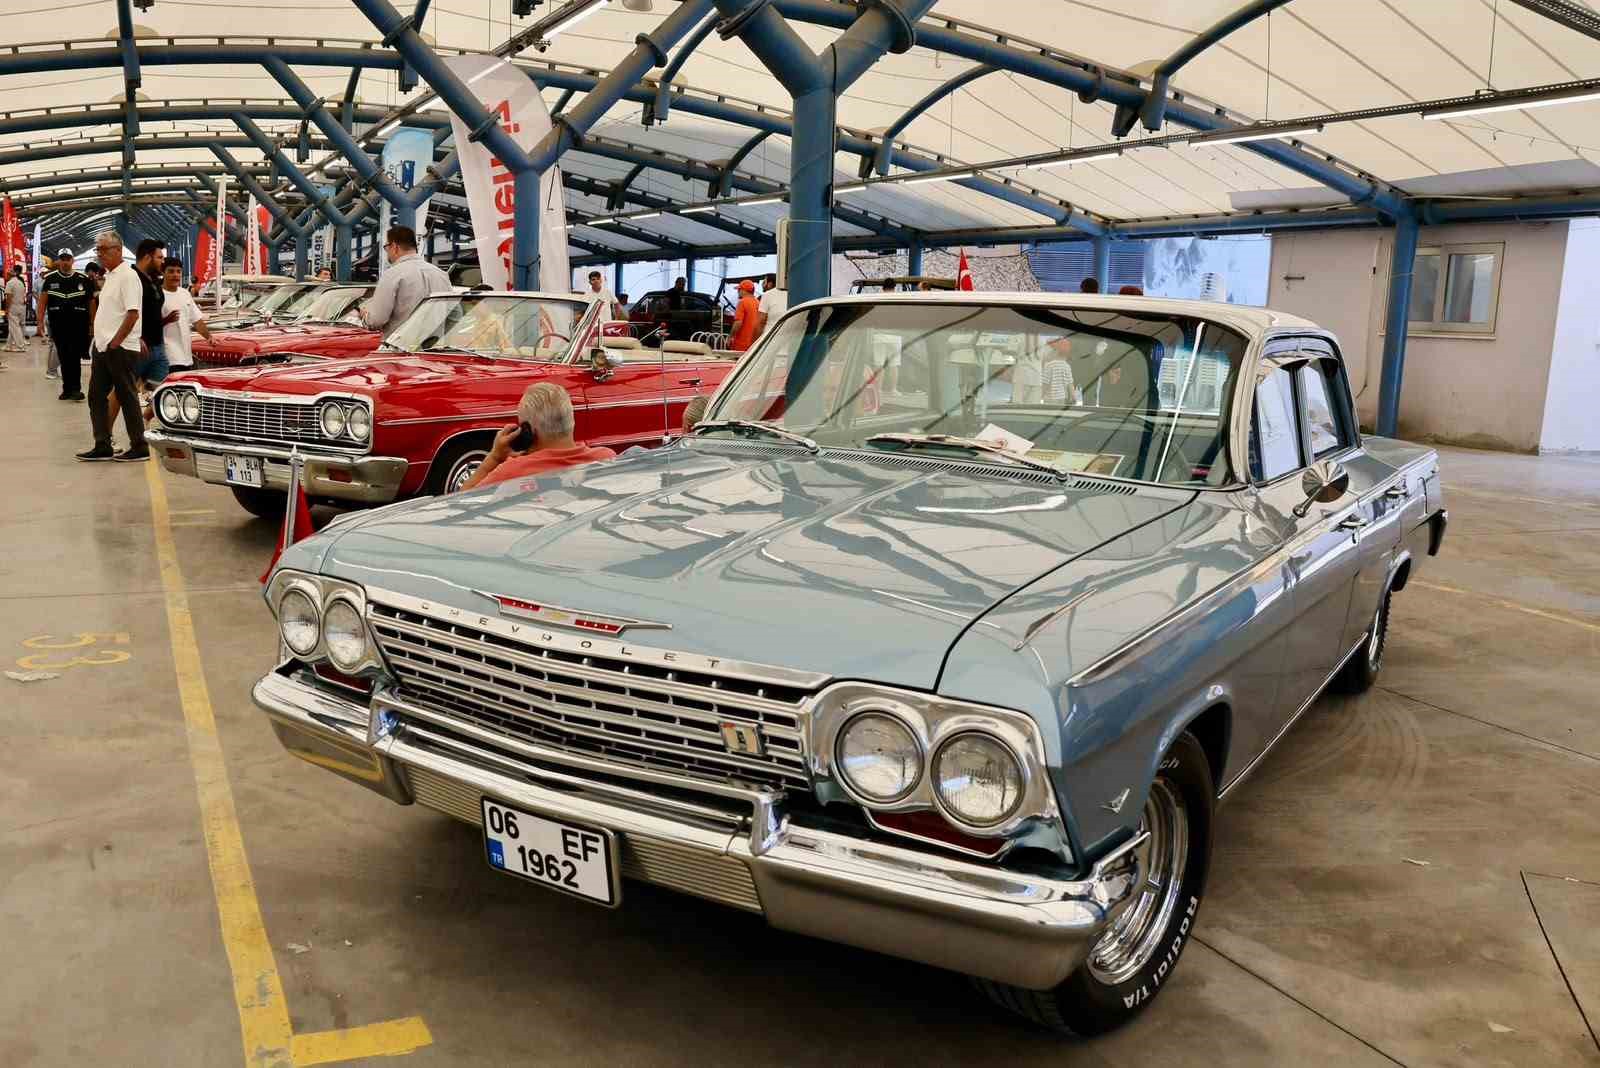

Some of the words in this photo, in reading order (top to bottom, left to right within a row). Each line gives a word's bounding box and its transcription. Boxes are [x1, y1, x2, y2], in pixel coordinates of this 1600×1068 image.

[240, 470, 252, 482] 113
[421, 603, 721, 669] CHEVROLET
[488, 806, 520, 840] 06
[561, 828, 600, 862] EF
[491, 852, 503, 865] TR
[517, 844, 580, 889] 1962
[1153, 895, 1199, 987] Radial
[1122, 984, 1151, 1009] T/A
